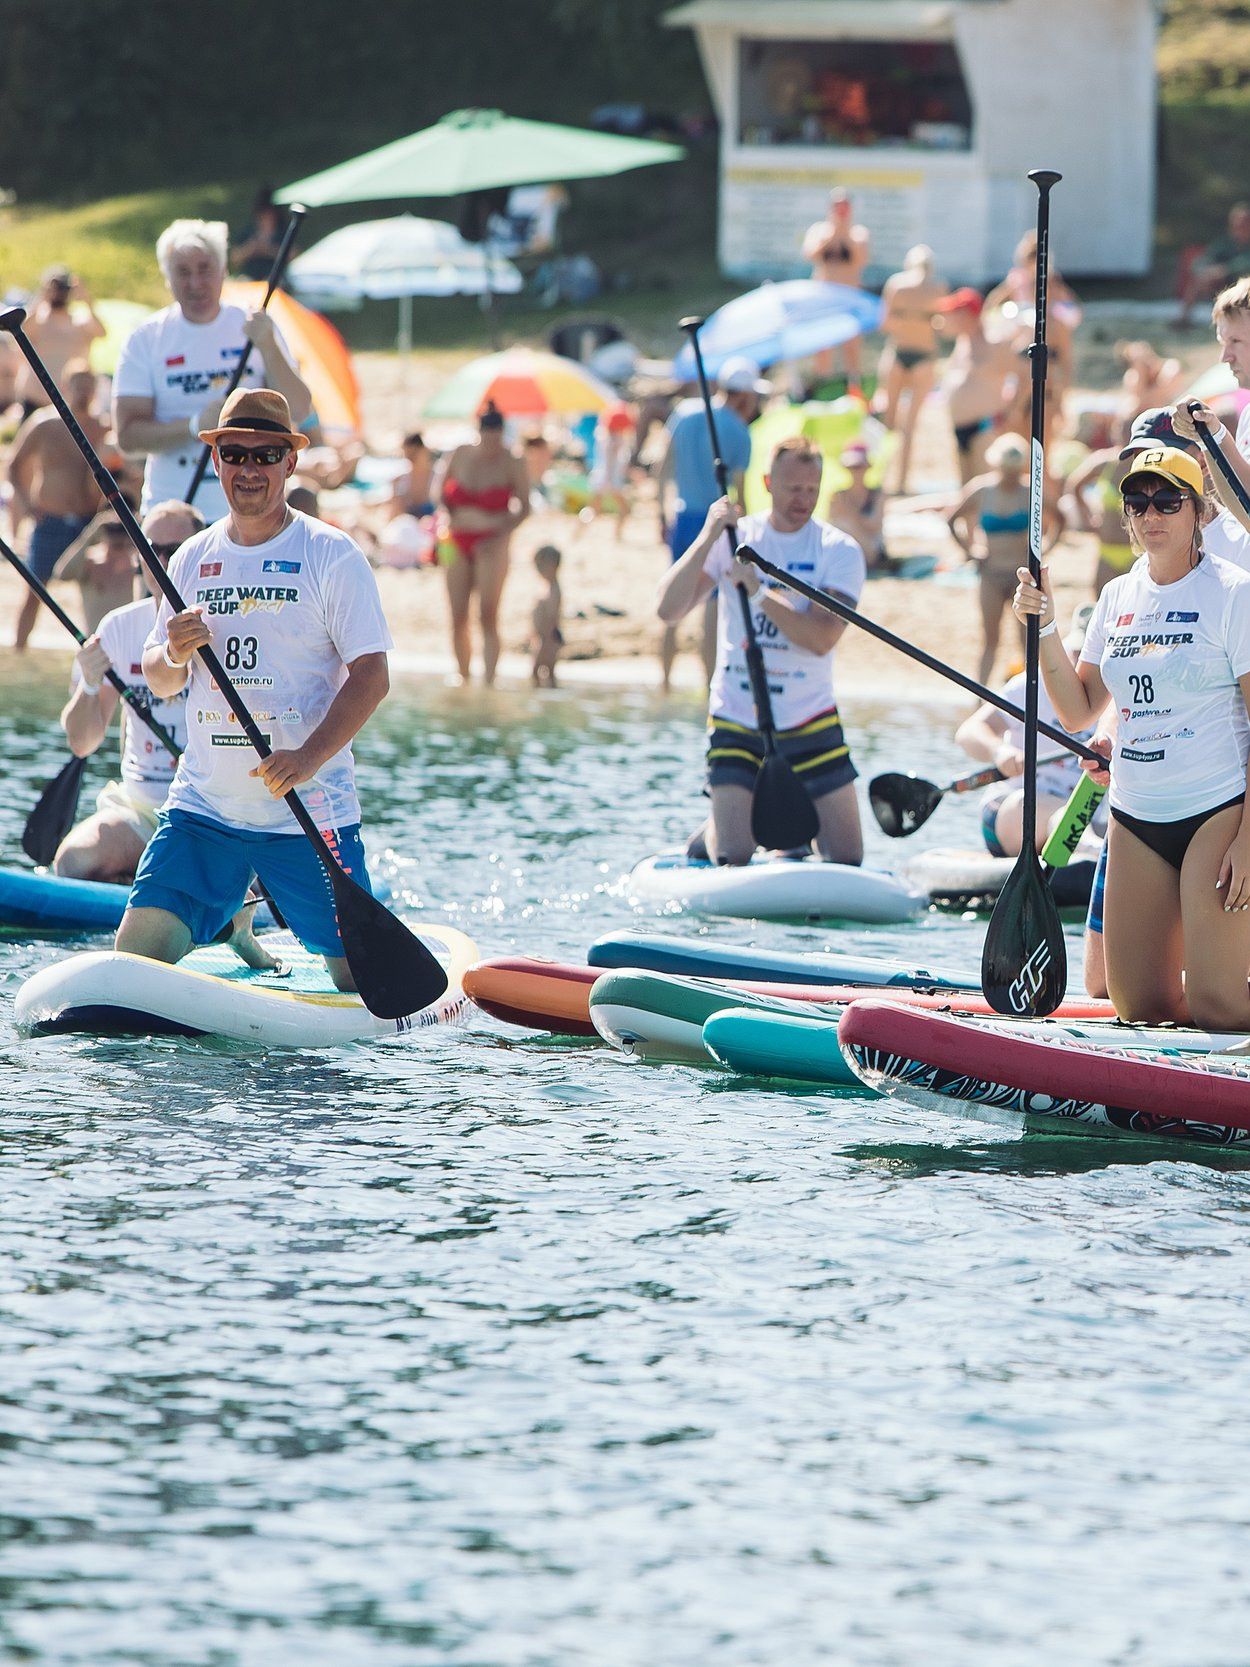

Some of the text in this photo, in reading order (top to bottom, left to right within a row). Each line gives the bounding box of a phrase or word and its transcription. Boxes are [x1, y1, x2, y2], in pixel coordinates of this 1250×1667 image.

[1033, 451, 1042, 550] HYDRO-FORCE
[196, 586, 299, 604] DEEP WATER
[207, 601, 239, 615] SUP
[1107, 632, 1194, 647] DEEP WATER
[225, 636, 258, 671] 83
[1109, 647, 1140, 659] SUP
[230, 676, 273, 686] astore.ru
[1128, 674, 1155, 704] 28
